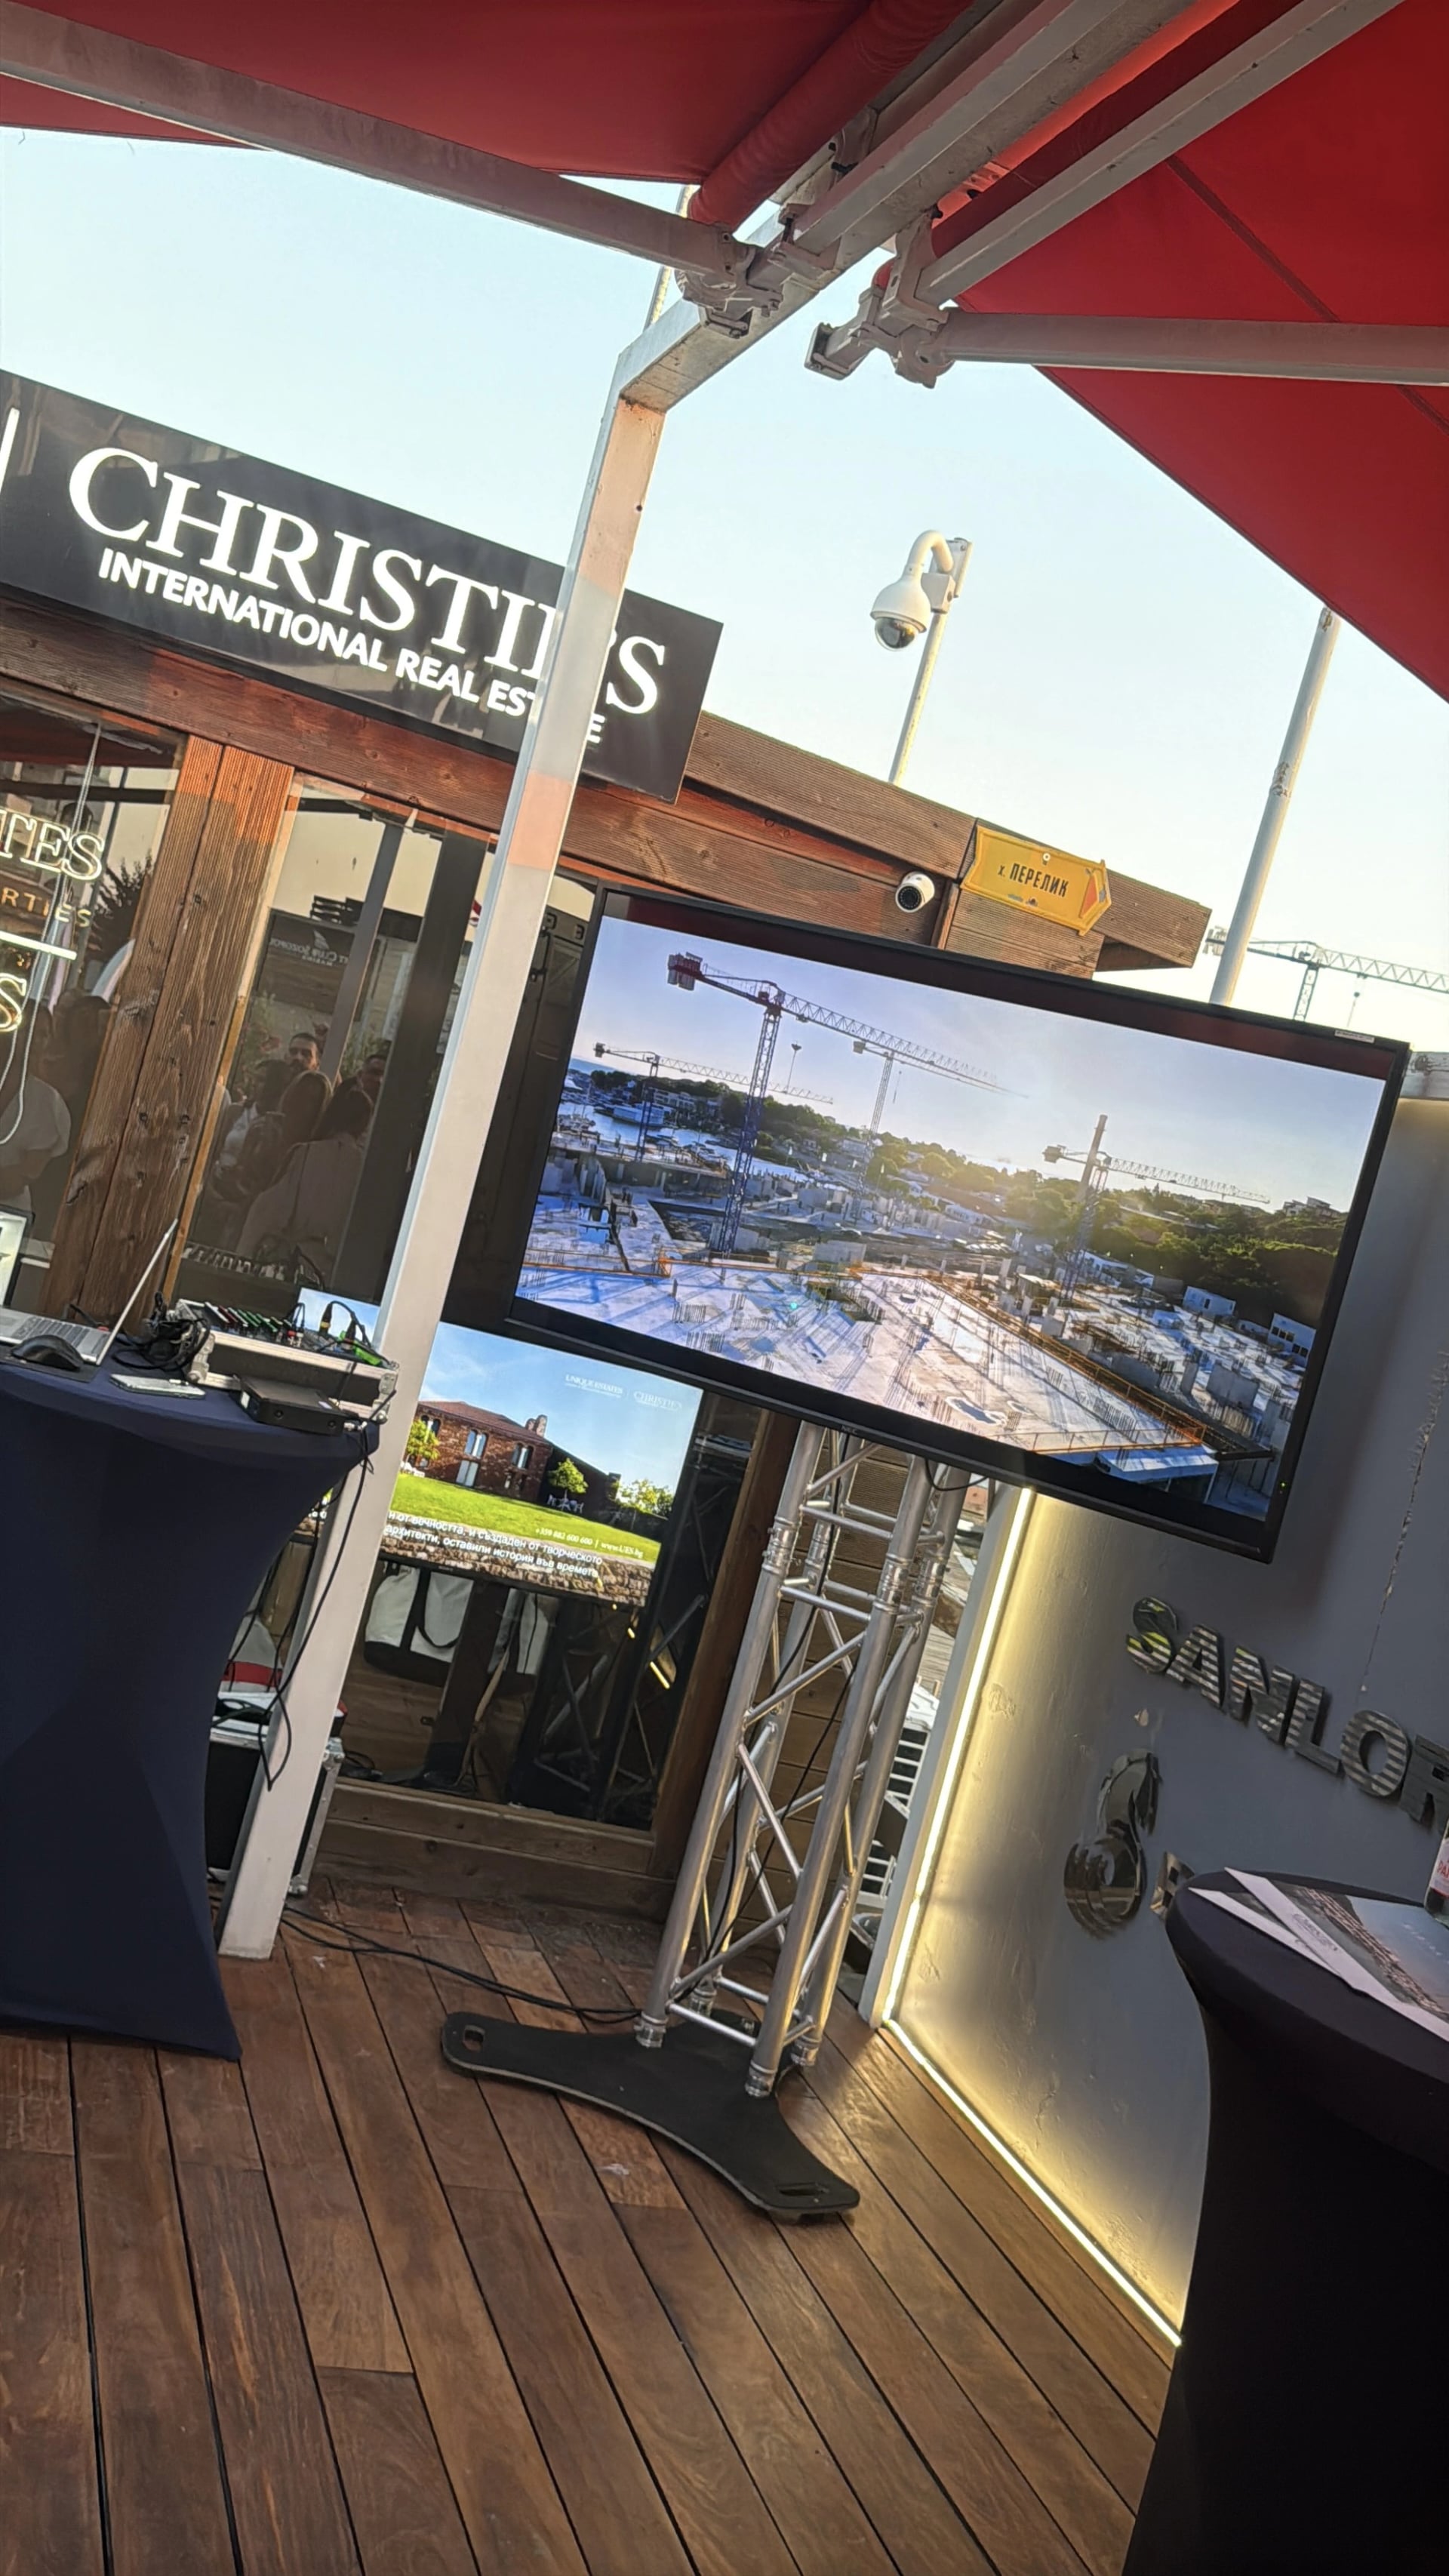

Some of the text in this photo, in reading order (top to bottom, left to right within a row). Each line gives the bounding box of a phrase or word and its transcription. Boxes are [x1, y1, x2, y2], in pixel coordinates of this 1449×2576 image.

[99, 549, 605, 743] INTERNATIONAL REAL ESE
[1010, 863, 1069, 897] ПЕРЕЛИК
[398, 1514, 408, 1522] от
[478, 1530, 527, 1548] създаден
[529, 1543, 540, 1551] от
[542, 1546, 602, 1565] творческото
[444, 1537, 491, 1554] оставили
[493, 1550, 534, 1563] история
[536, 1557, 555, 1568] във
